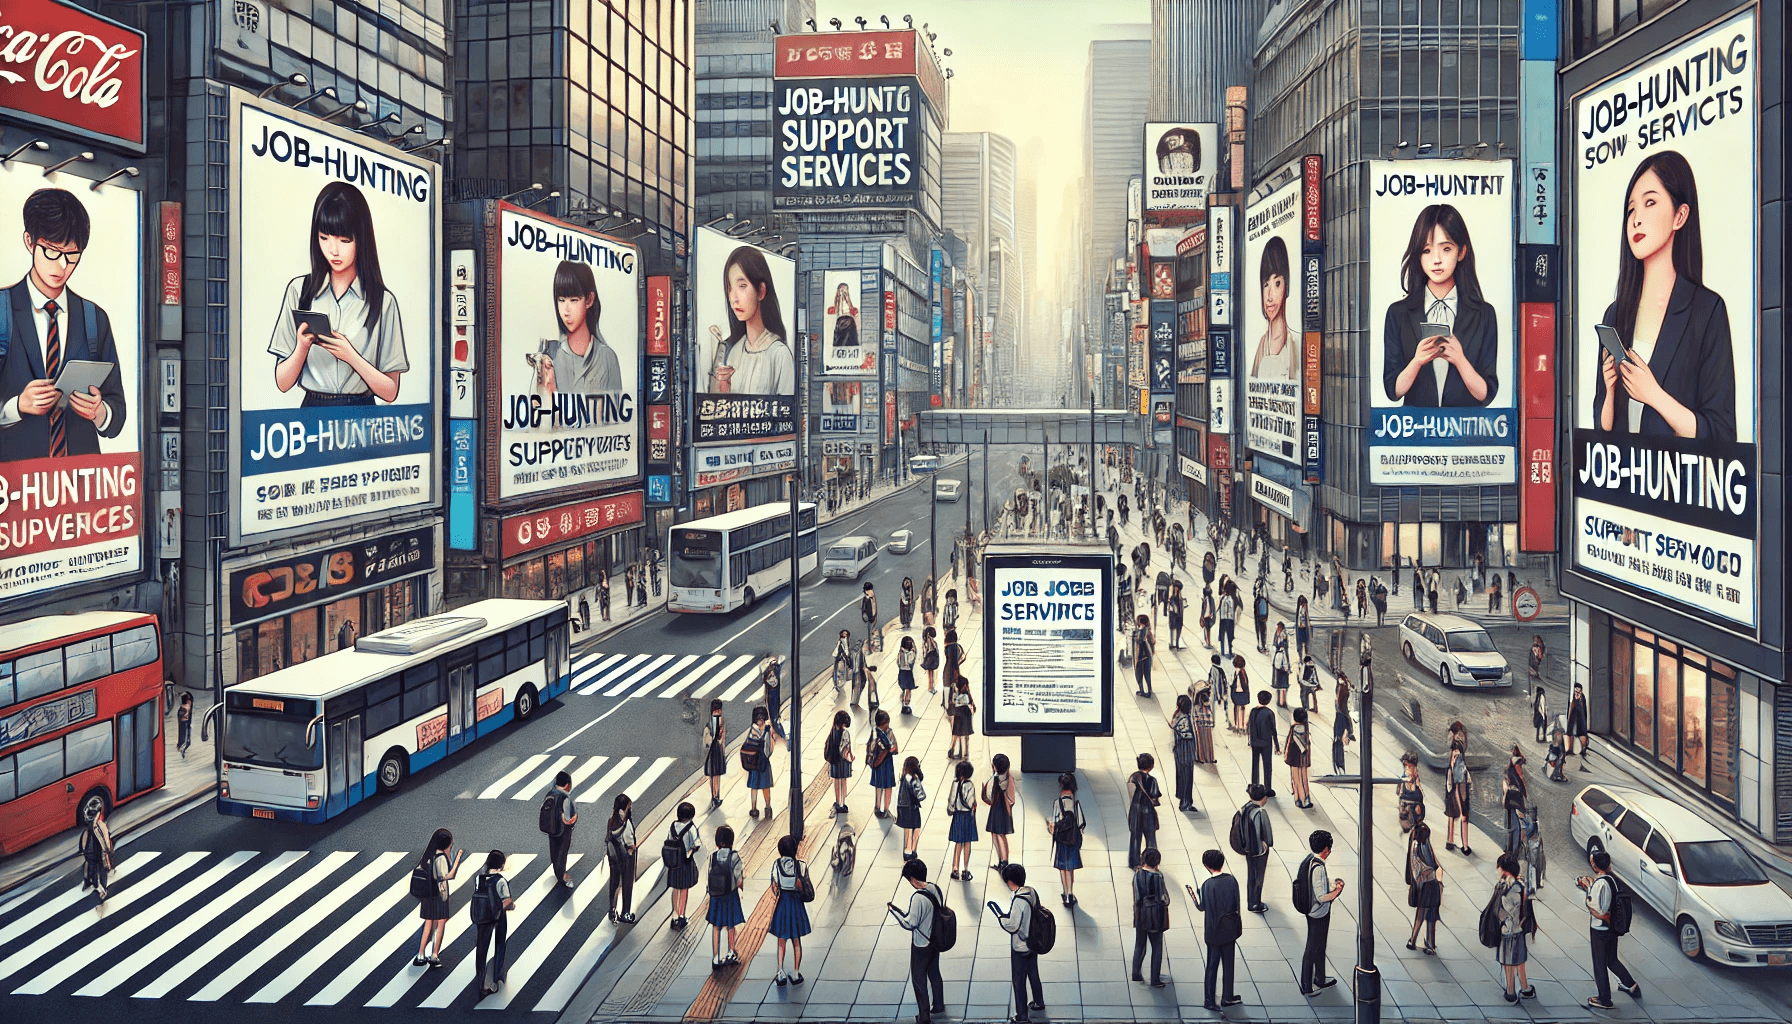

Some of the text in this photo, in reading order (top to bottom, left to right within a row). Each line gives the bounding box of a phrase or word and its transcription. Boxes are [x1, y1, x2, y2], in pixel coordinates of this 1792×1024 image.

[1582, 33, 1747, 139] JOB-HUNTING
[782, 117, 909, 151] SUPPORT
[252, 125, 428, 202] JOB-HUNTING
[781, 152, 911, 188] SERVICES
[508, 221, 634, 274] JOB-HUNTING
[504, 393, 633, 429] JOB-HUNTING
[1374, 414, 1508, 439] JOB-HUNTING
[1579, 442, 1747, 515] JOB-HUNTING
